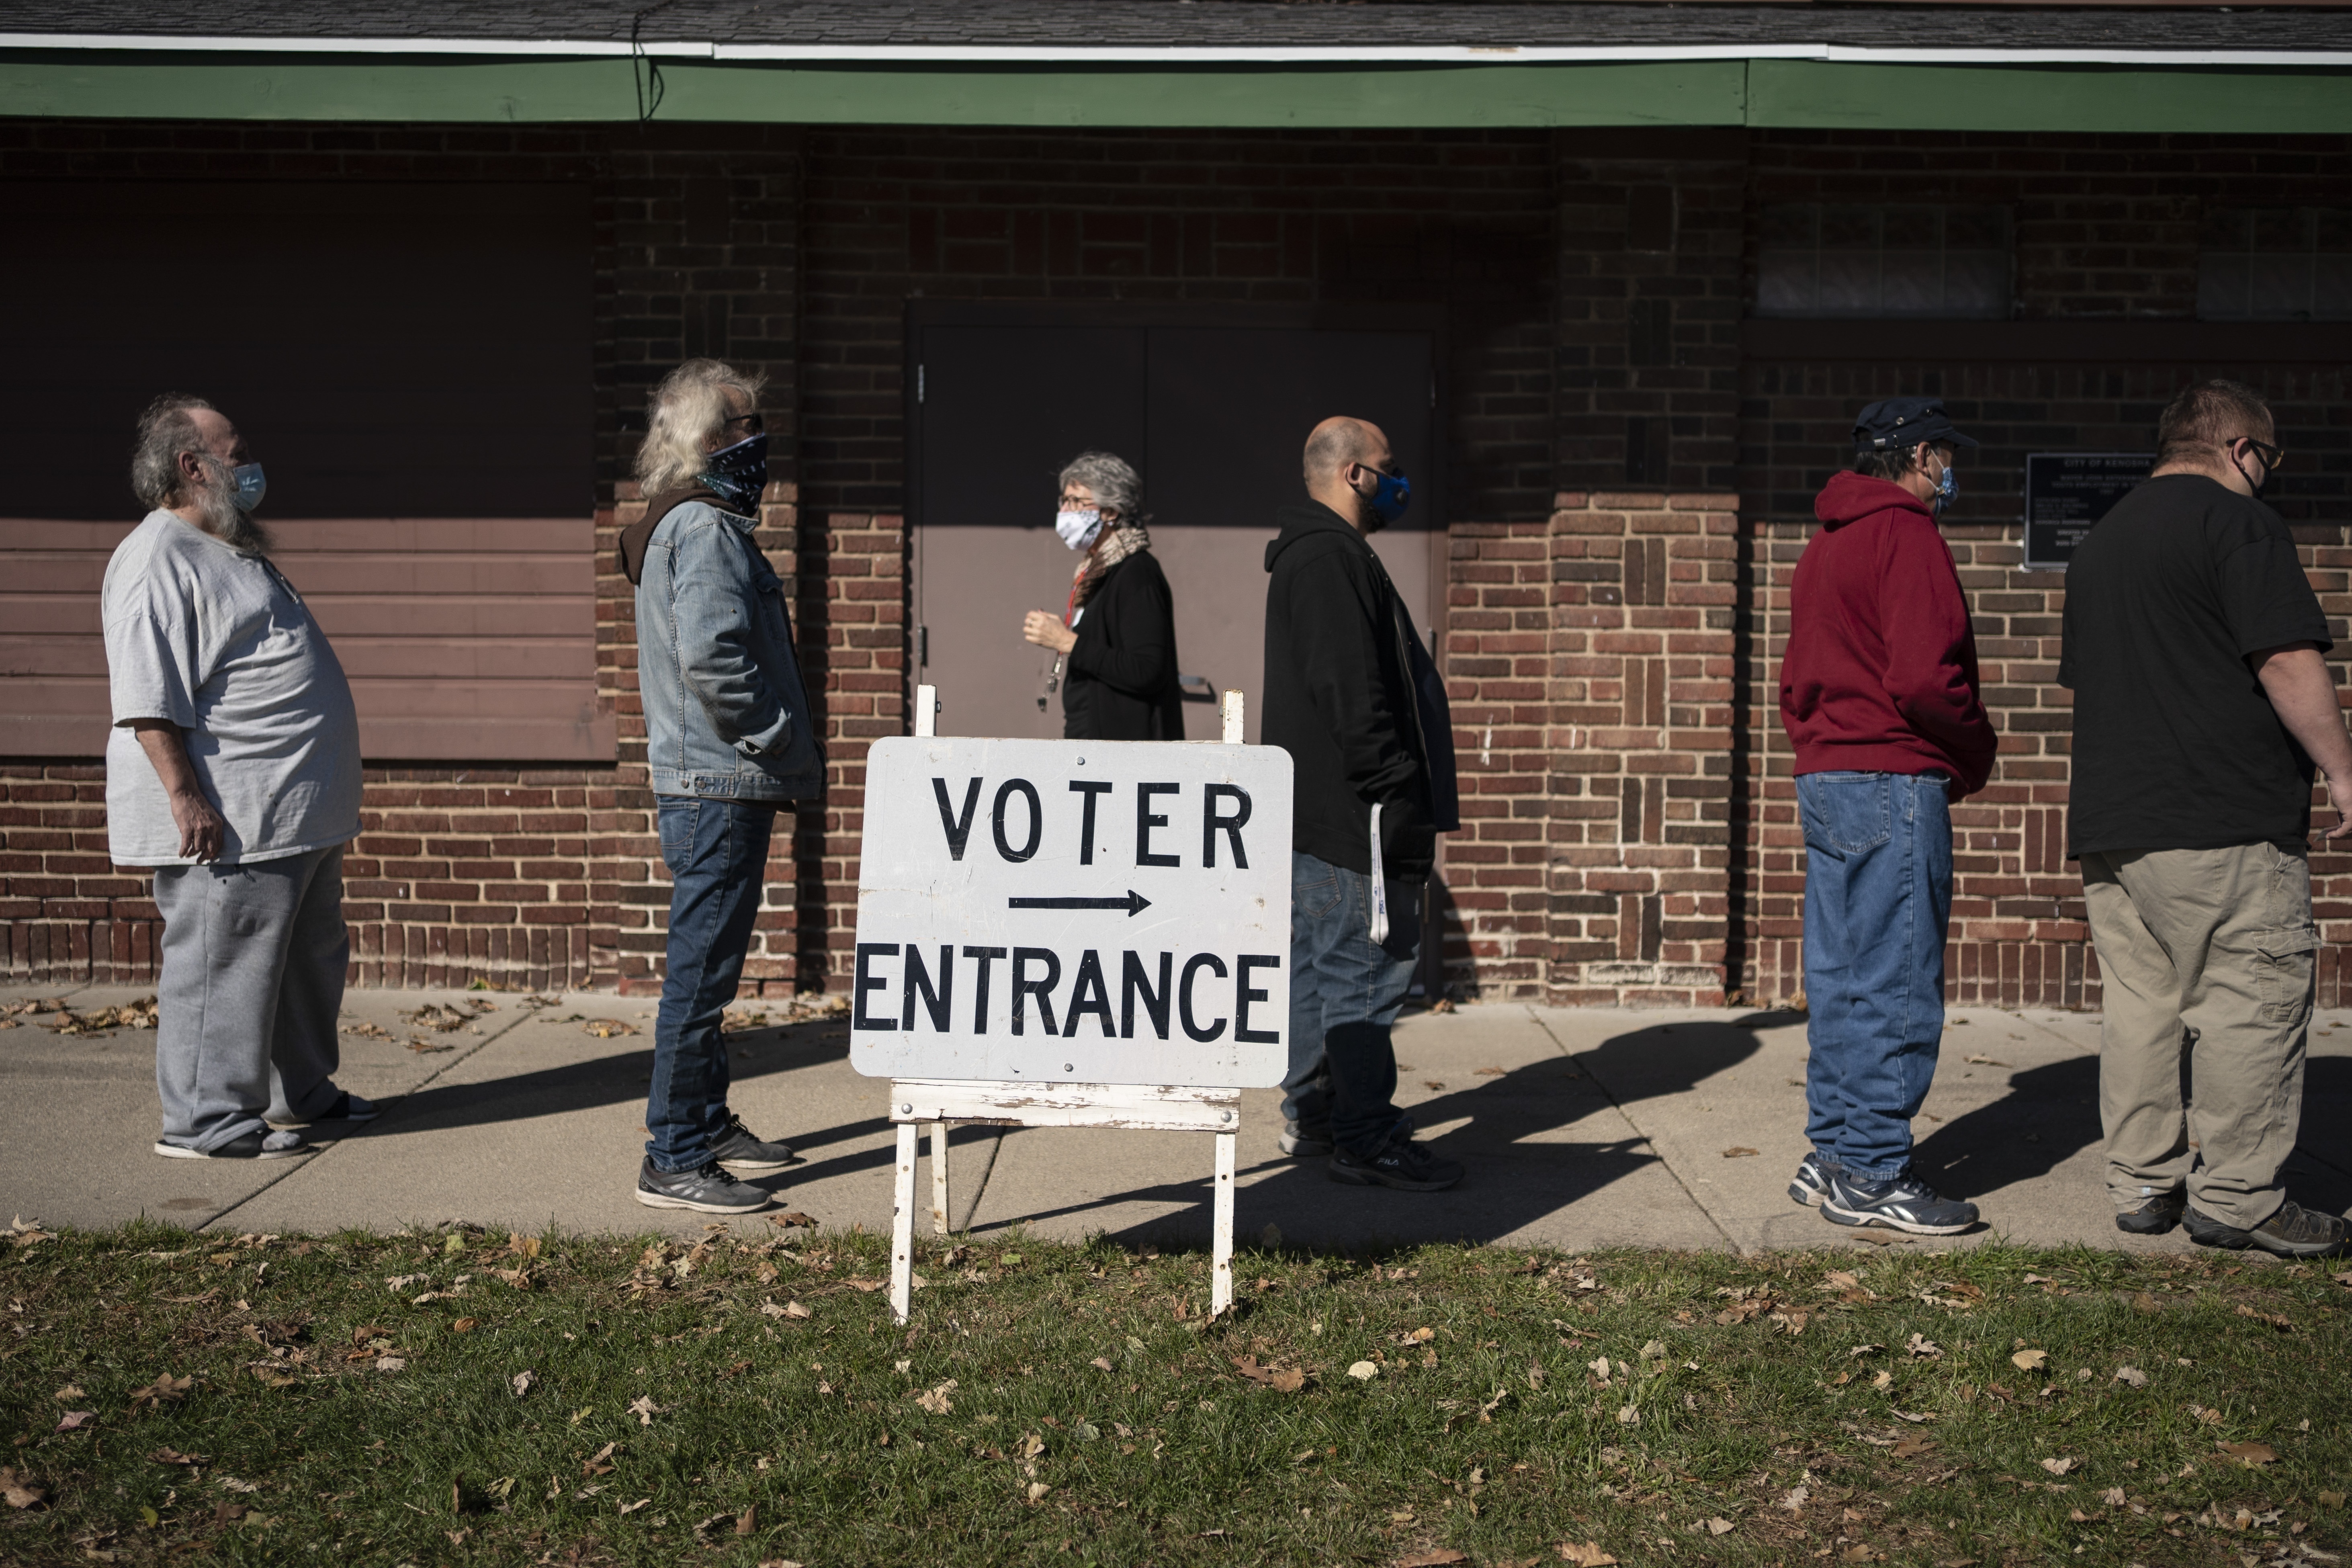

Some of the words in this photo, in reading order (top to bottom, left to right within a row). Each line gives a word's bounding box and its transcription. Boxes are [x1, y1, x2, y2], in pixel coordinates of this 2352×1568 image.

[2065, 459, 2086, 468] CITY
[2088, 459, 2102, 468] OF
[2105, 459, 2150, 468] KENOSHA
[931, 777, 1253, 869] VOTER
[854, 943, 1280, 1044] ENTRANCE
